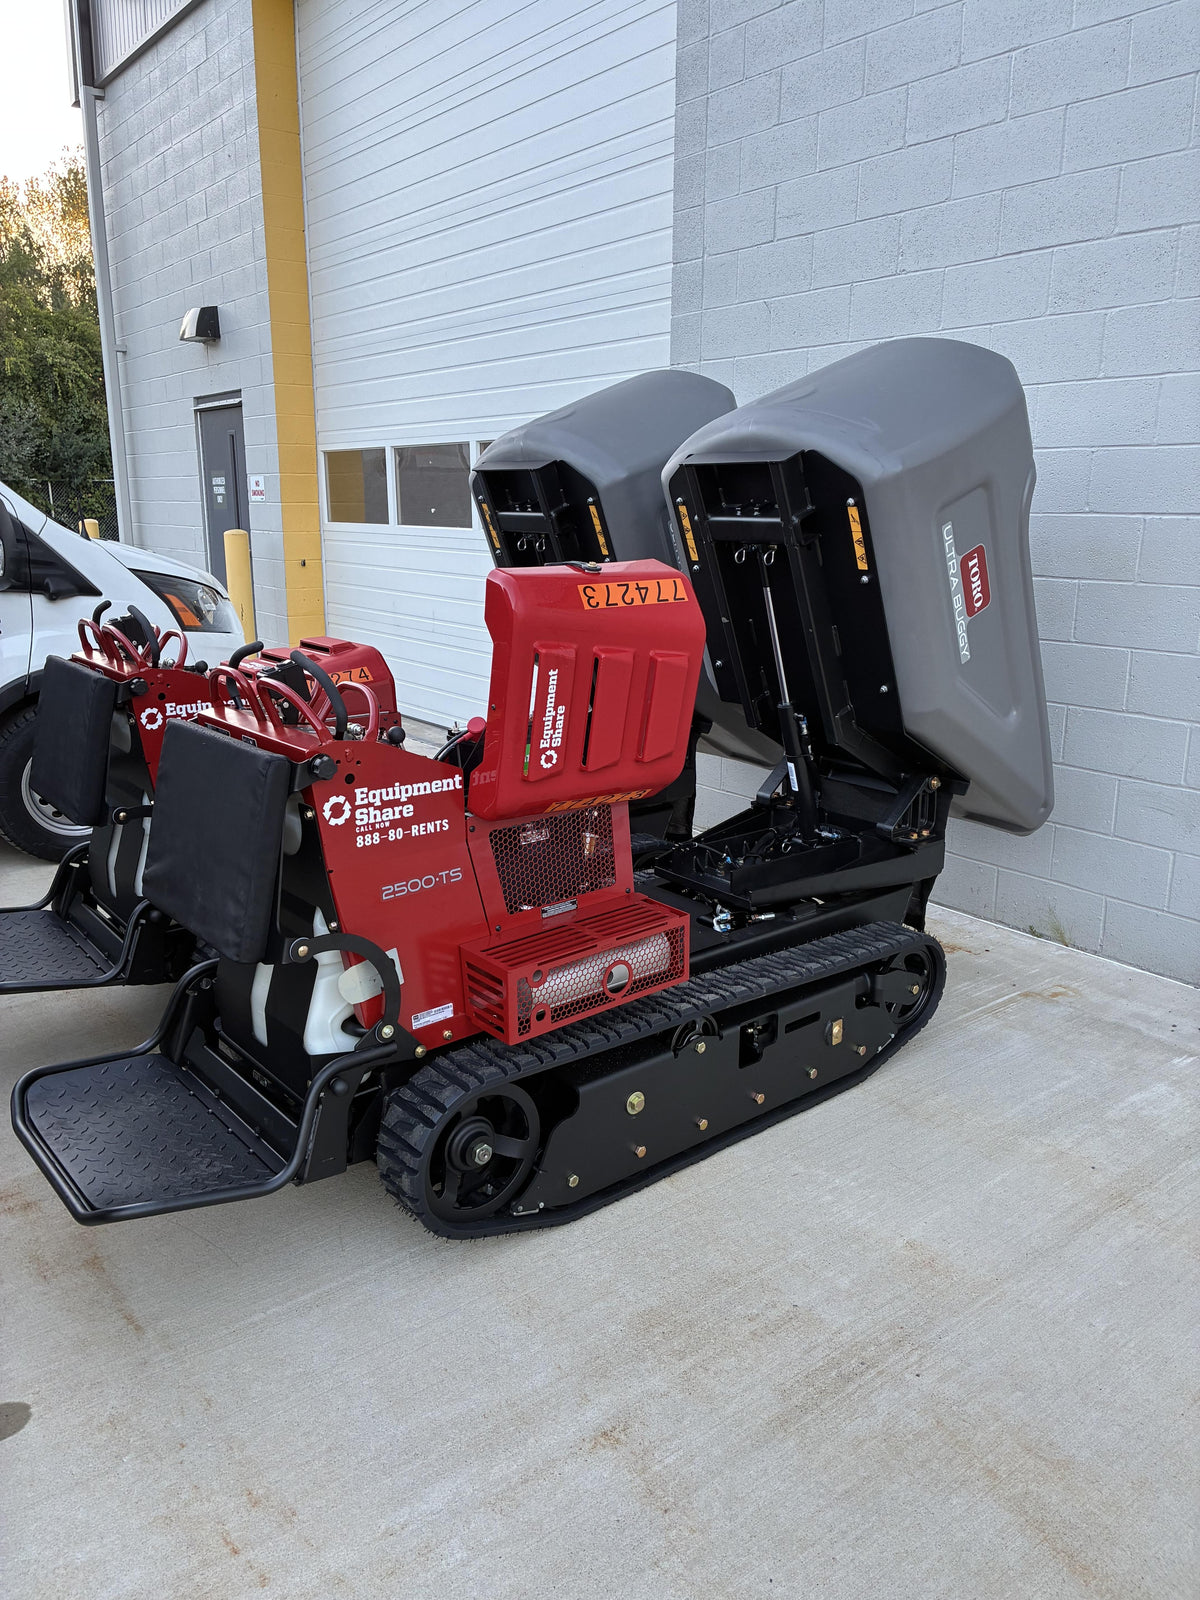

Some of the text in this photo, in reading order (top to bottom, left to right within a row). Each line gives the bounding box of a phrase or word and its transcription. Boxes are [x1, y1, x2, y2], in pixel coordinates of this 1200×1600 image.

[251, 489, 265, 497] SMOKING
[583, 580, 685, 608] 774273
[943, 524, 970, 657] ULTRA BUGGY
[968, 553, 984, 608] TORO
[540, 668, 558, 749] Equipment
[551, 705, 565, 748] Share
[354, 774, 462, 806] Equipment
[355, 804, 414, 826] Share
[355, 821, 390, 833] CALL NOW
[356, 819, 449, 848] 888-80-RENTS
